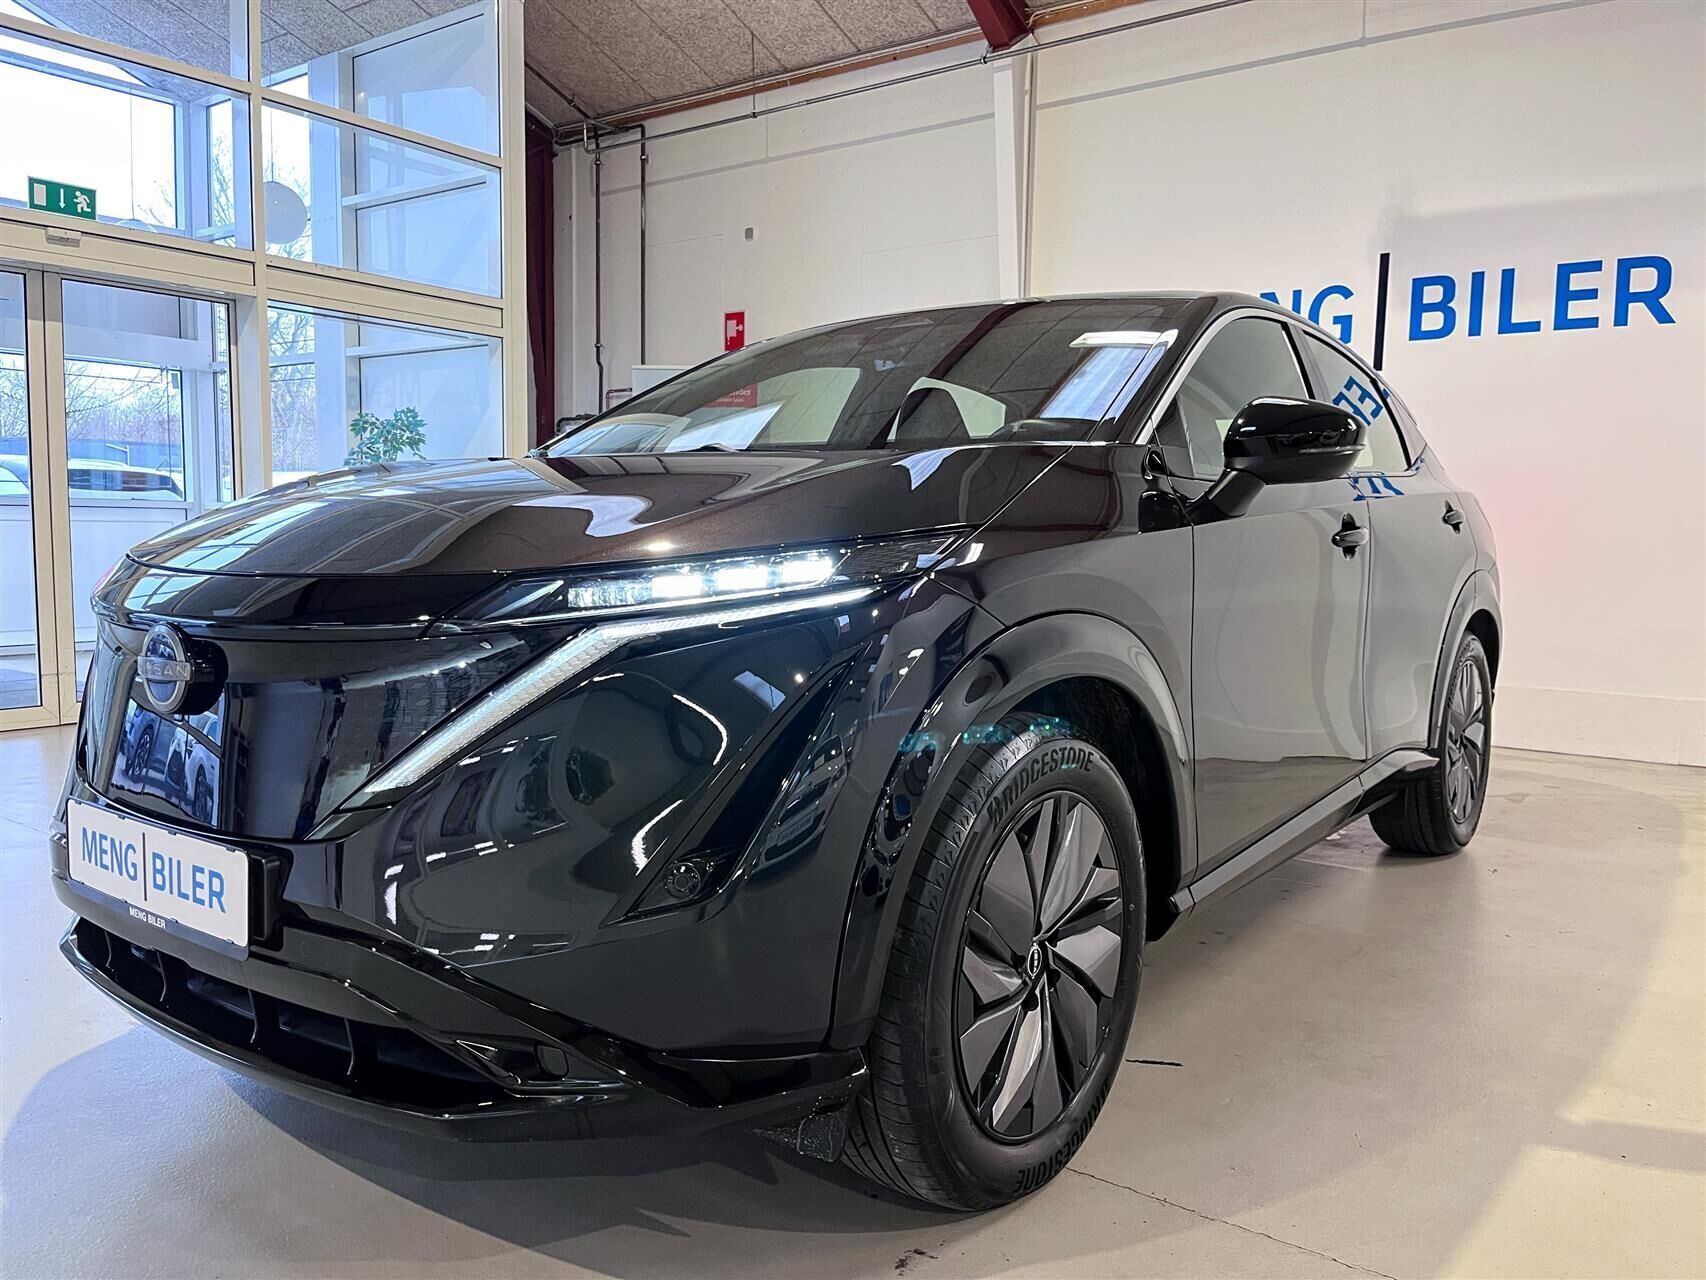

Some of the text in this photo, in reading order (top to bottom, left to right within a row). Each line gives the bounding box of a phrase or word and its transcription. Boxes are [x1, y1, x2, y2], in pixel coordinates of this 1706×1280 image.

[1408, 255, 1677, 342] BILER
[140, 660, 189, 678] SSAN
[986, 746, 1094, 833] BRIDGESTONE
[82, 826, 226, 913] MENG BILER
[129, 907, 166, 930] MENG BILER
